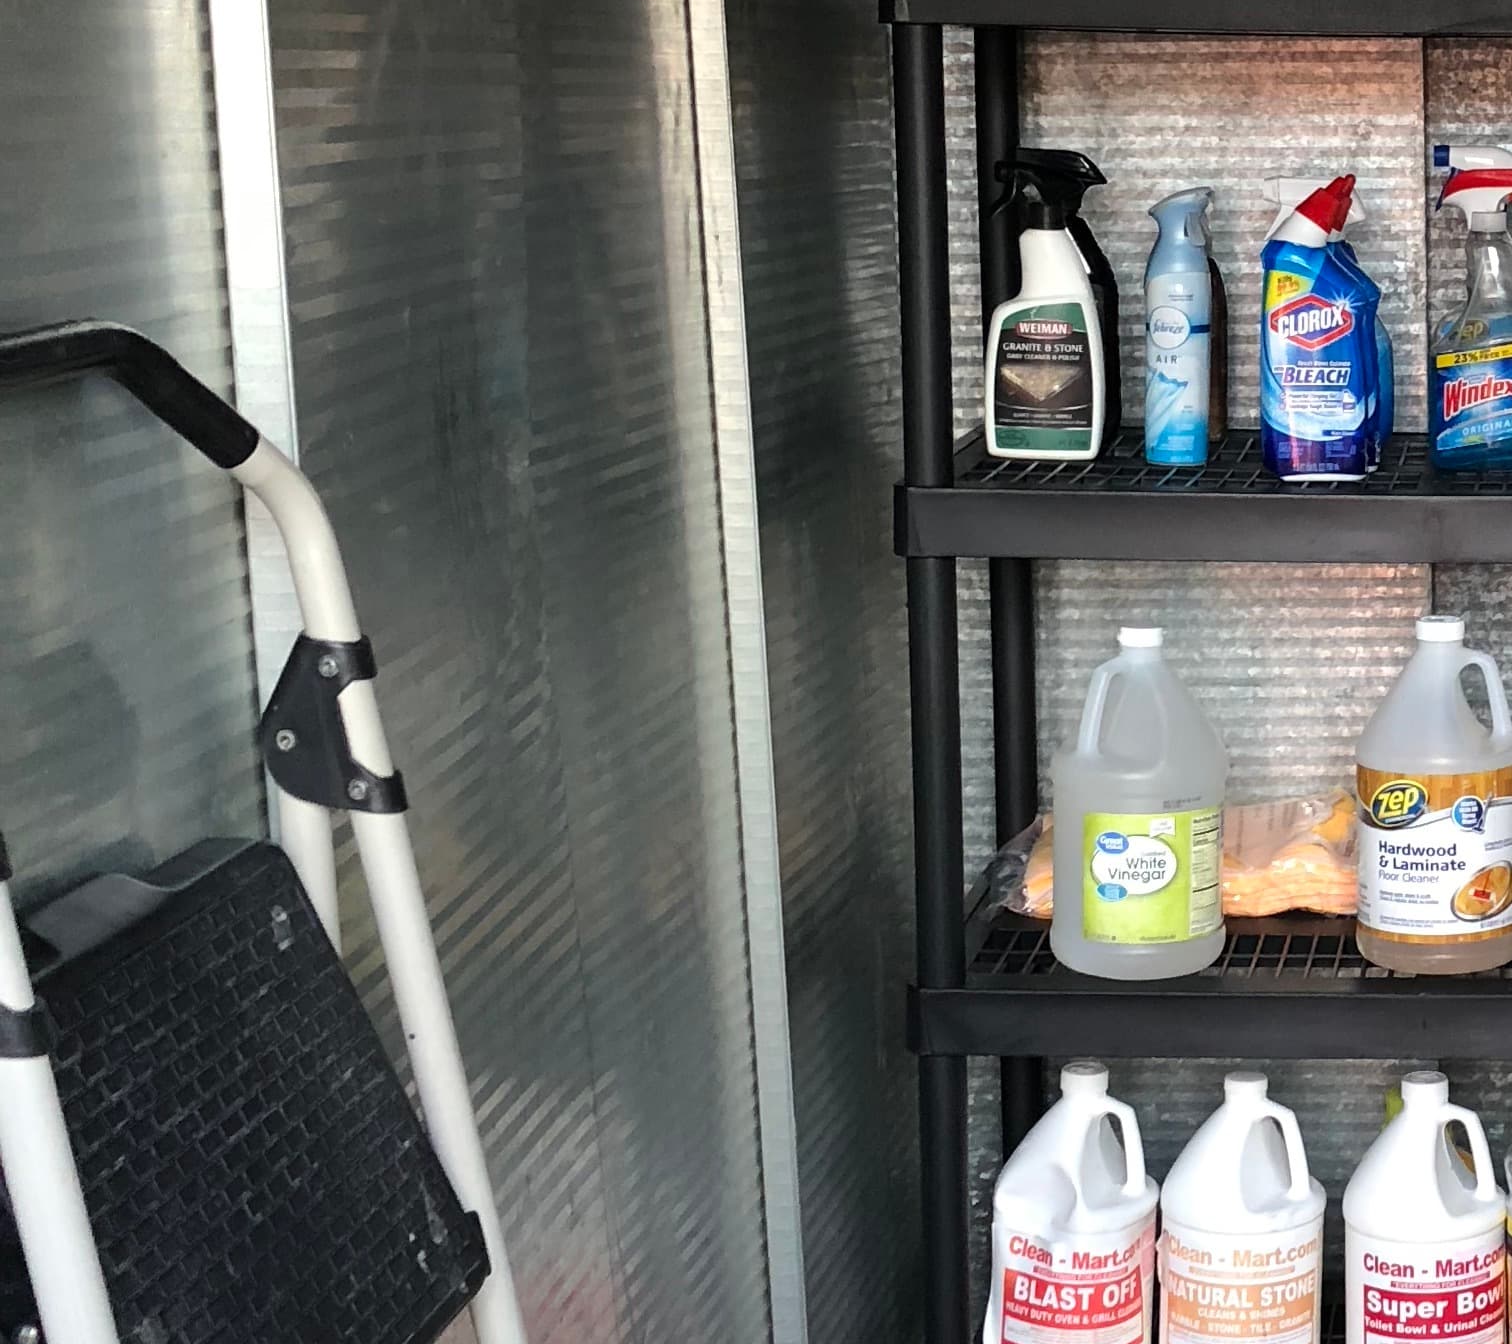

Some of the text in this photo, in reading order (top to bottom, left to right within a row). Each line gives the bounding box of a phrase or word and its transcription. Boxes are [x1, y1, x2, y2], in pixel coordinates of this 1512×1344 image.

[1018, 322, 1068, 335] WEIMAN
[1277, 304, 1346, 340] CLOROX
[1002, 342, 1042, 353] GRANITE
[1054, 343, 1084, 353] STONE
[1156, 354, 1178, 364] AIR
[1284, 366, 1350, 385] BLEACH
[1378, 840, 1457, 857] Hardwood
[1126, 856, 1167, 869] White
[1379, 855, 1467, 872] & Laminate
[1108, 868, 1166, 884] Vinegar
[1378, 869, 1440, 884] Floor Cleaner
[1009, 1235, 1053, 1267] Clean
[1363, 1252, 1415, 1278] Clean
[1014, 1275, 1095, 1311] BLAST
[1102, 1273, 1138, 1308] OFF
[1169, 1273, 1254, 1308] NATURAL
[1260, 1273, 1315, 1307] STONE
[1367, 1289, 1449, 1323] Super
[1365, 1316, 1393, 1333] Toilet
[1396, 1323, 1427, 1335] Bowl
[1430, 1323, 1440, 1334] &
[1443, 1318, 1478, 1333] Urinal
